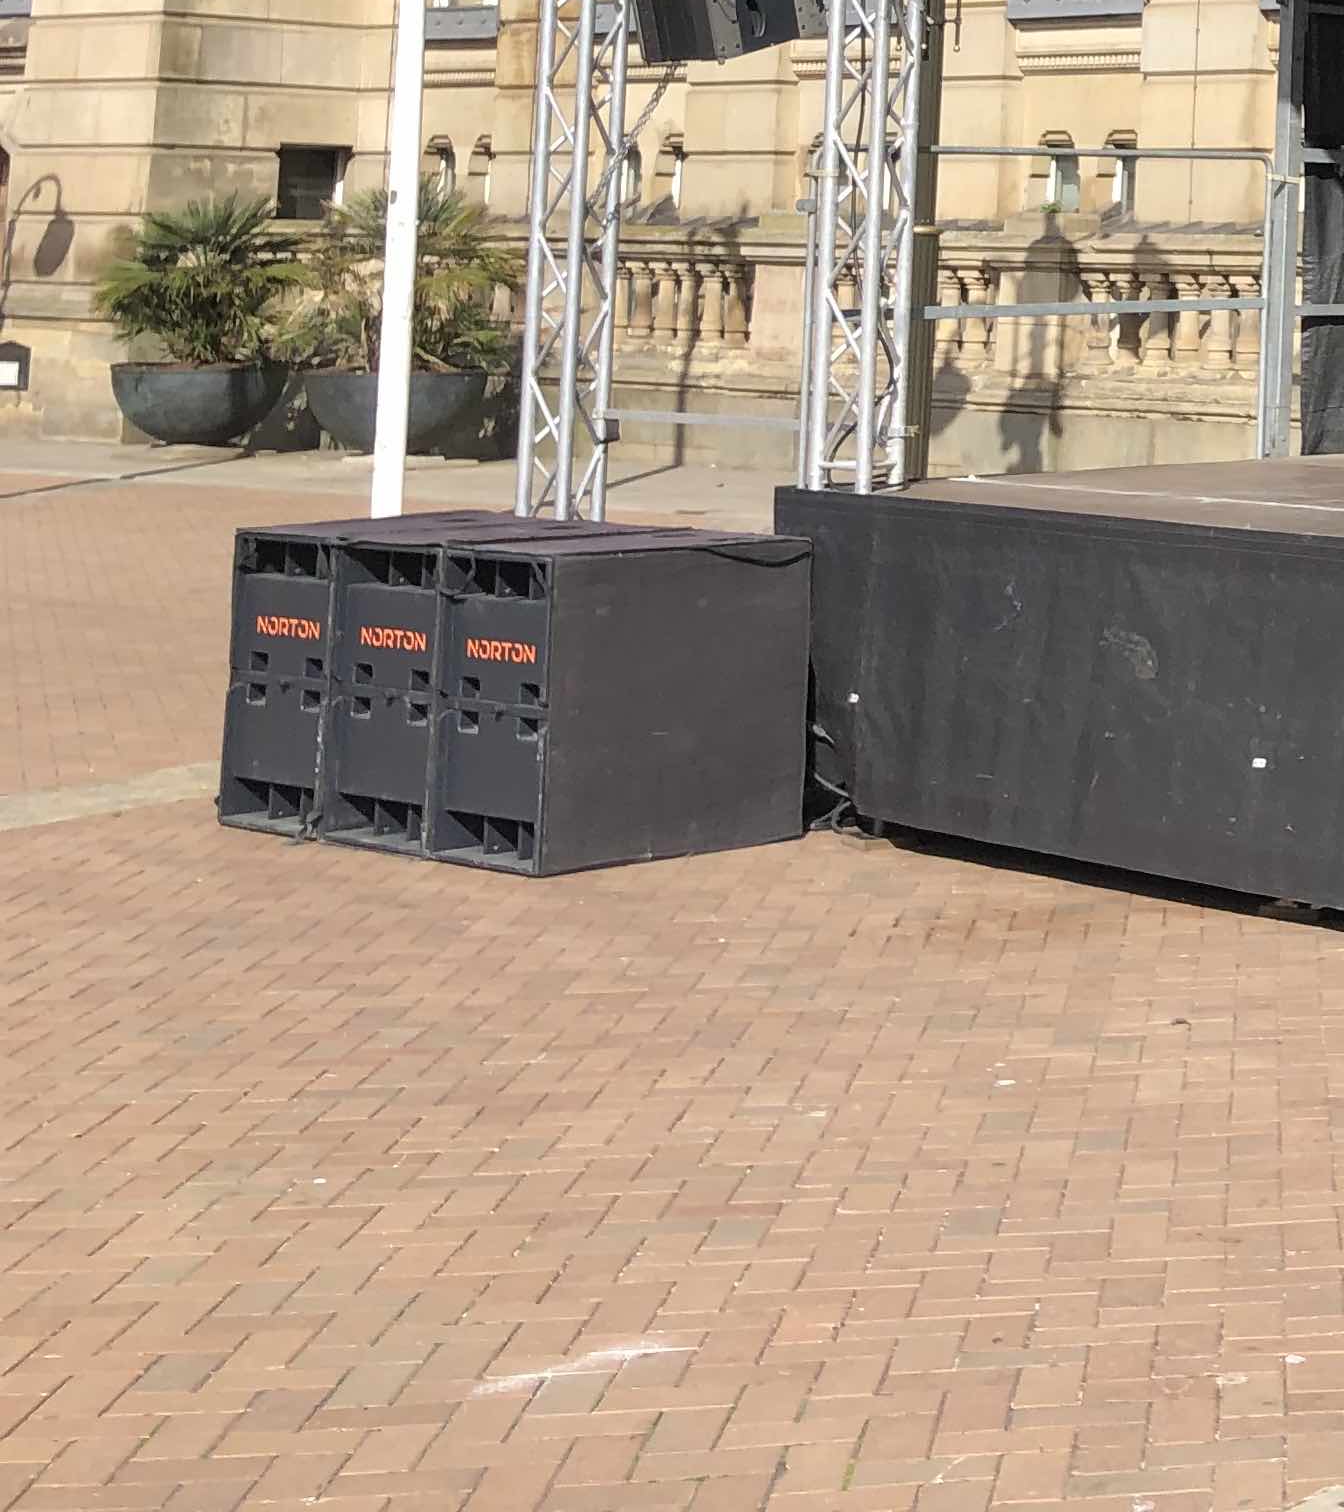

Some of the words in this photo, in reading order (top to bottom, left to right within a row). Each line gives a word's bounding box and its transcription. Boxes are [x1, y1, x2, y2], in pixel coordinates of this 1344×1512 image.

[256, 615, 321, 640] NORTON
[360, 626, 427, 652] NORTON
[466, 639, 536, 664] NORTON
